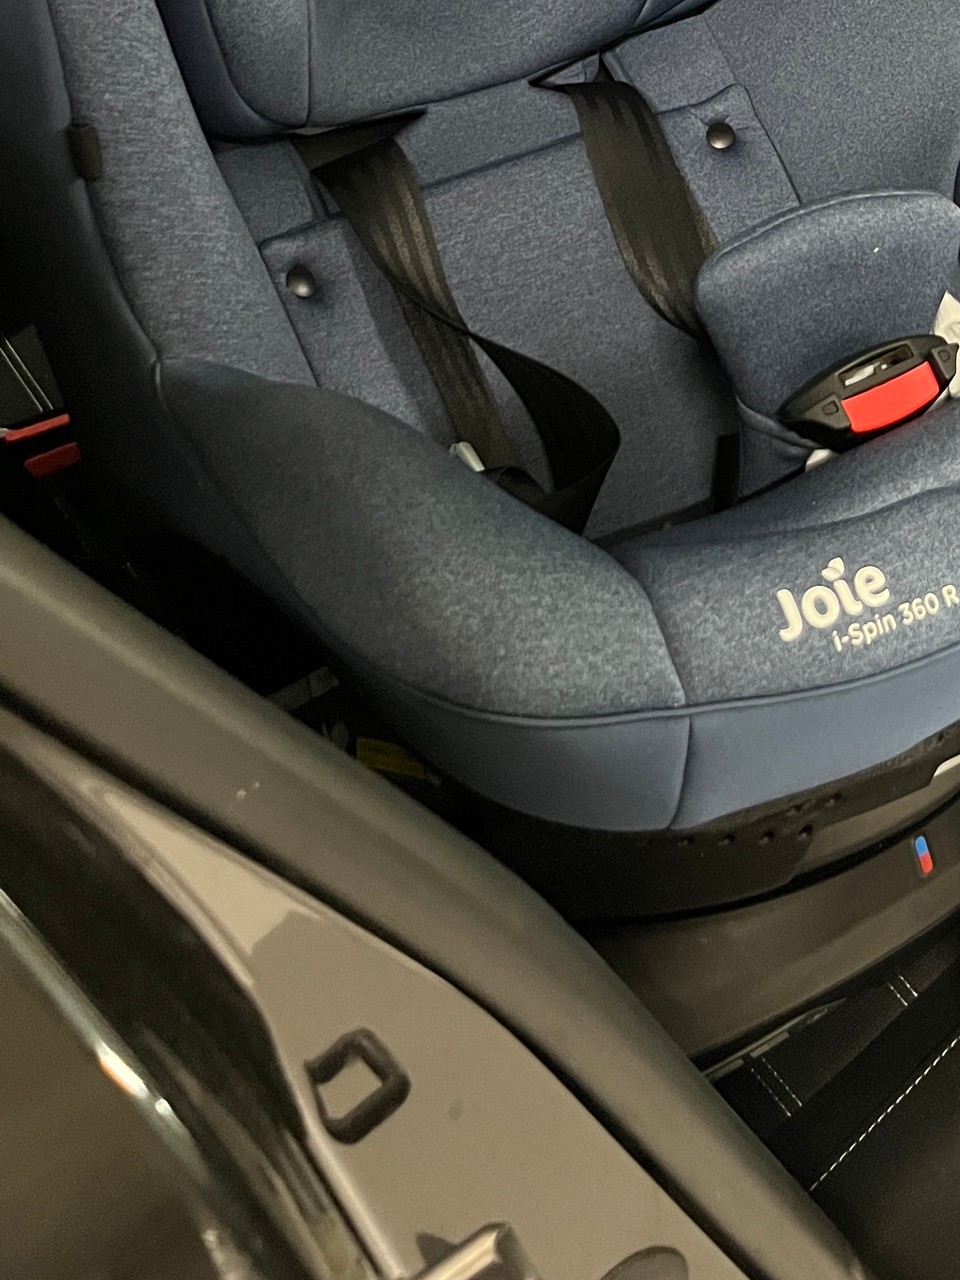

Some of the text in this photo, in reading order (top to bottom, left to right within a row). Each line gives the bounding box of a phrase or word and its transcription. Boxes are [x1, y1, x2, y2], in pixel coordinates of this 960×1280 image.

[776, 556, 891, 642] Joie
[831, 584, 960, 652] i-Spin 360 R
